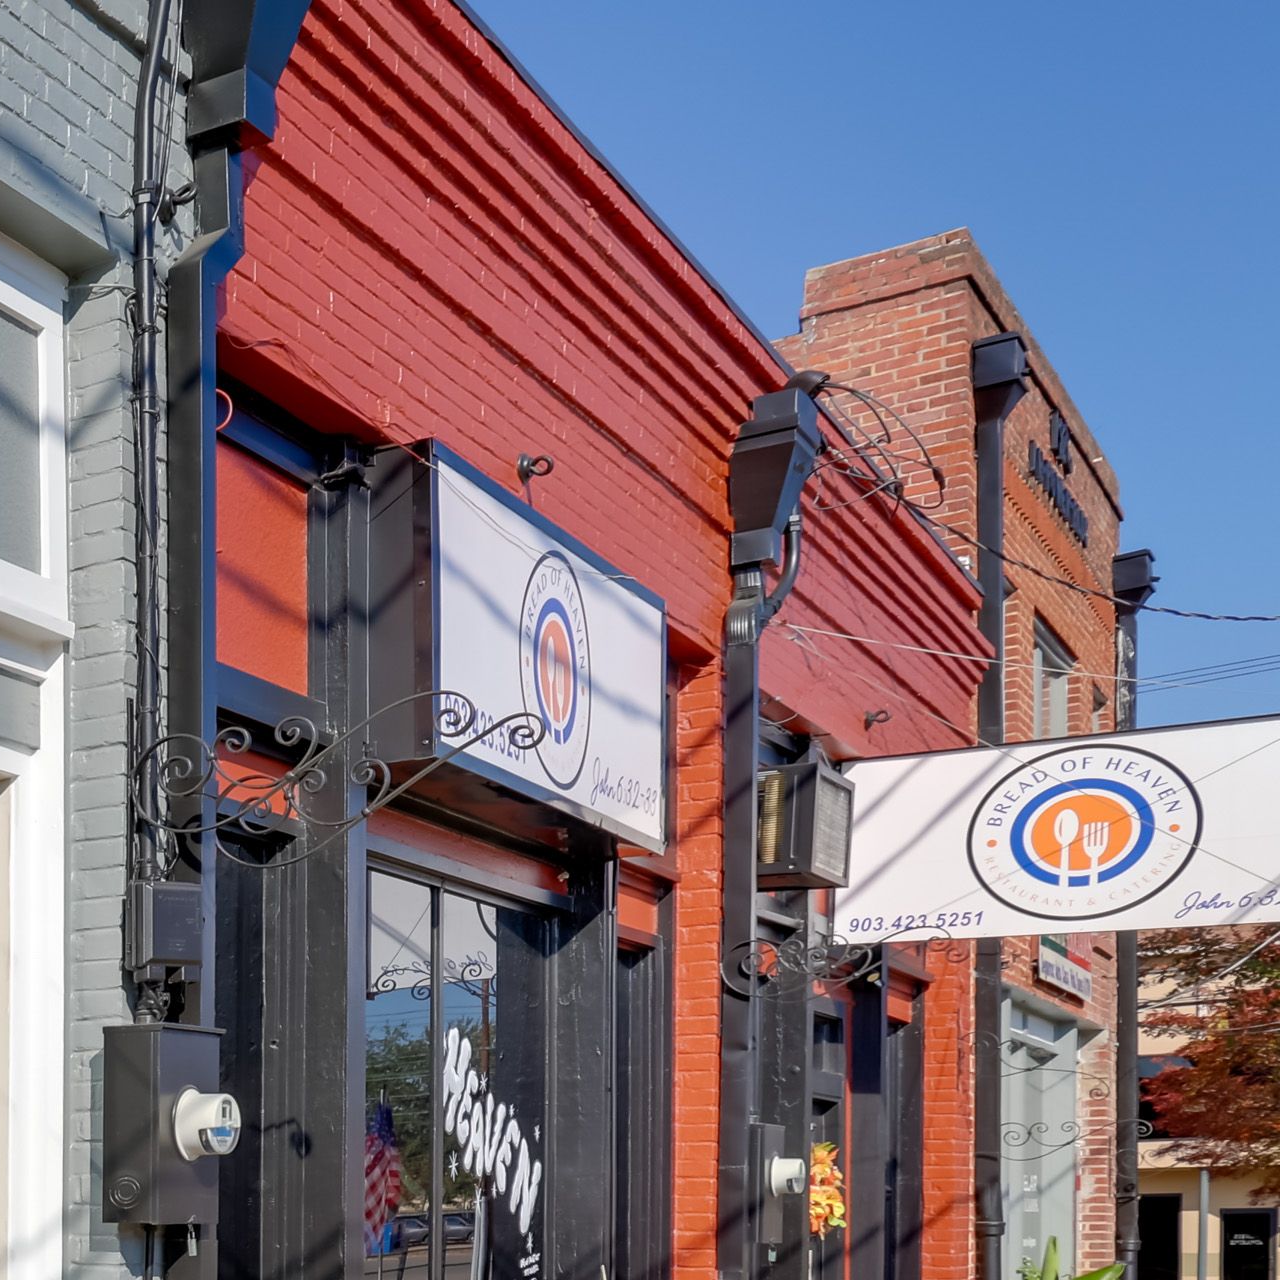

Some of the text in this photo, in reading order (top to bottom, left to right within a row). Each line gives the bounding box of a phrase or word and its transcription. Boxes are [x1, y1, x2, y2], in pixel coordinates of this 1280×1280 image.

[525, 568, 585, 669] BREAD OF HEAVEN
[591, 756, 616, 806] John
[987, 756, 1184, 827] BREAD OF HEAVEN
[983, 856, 1074, 907] RESTAURANT
[1108, 842, 1183, 901] CATERING
[1174, 889, 1280, 919] John 6:3
[848, 910, 984, 933] 903.423.5251
[443, 1027, 542, 1235] HEAVEN
